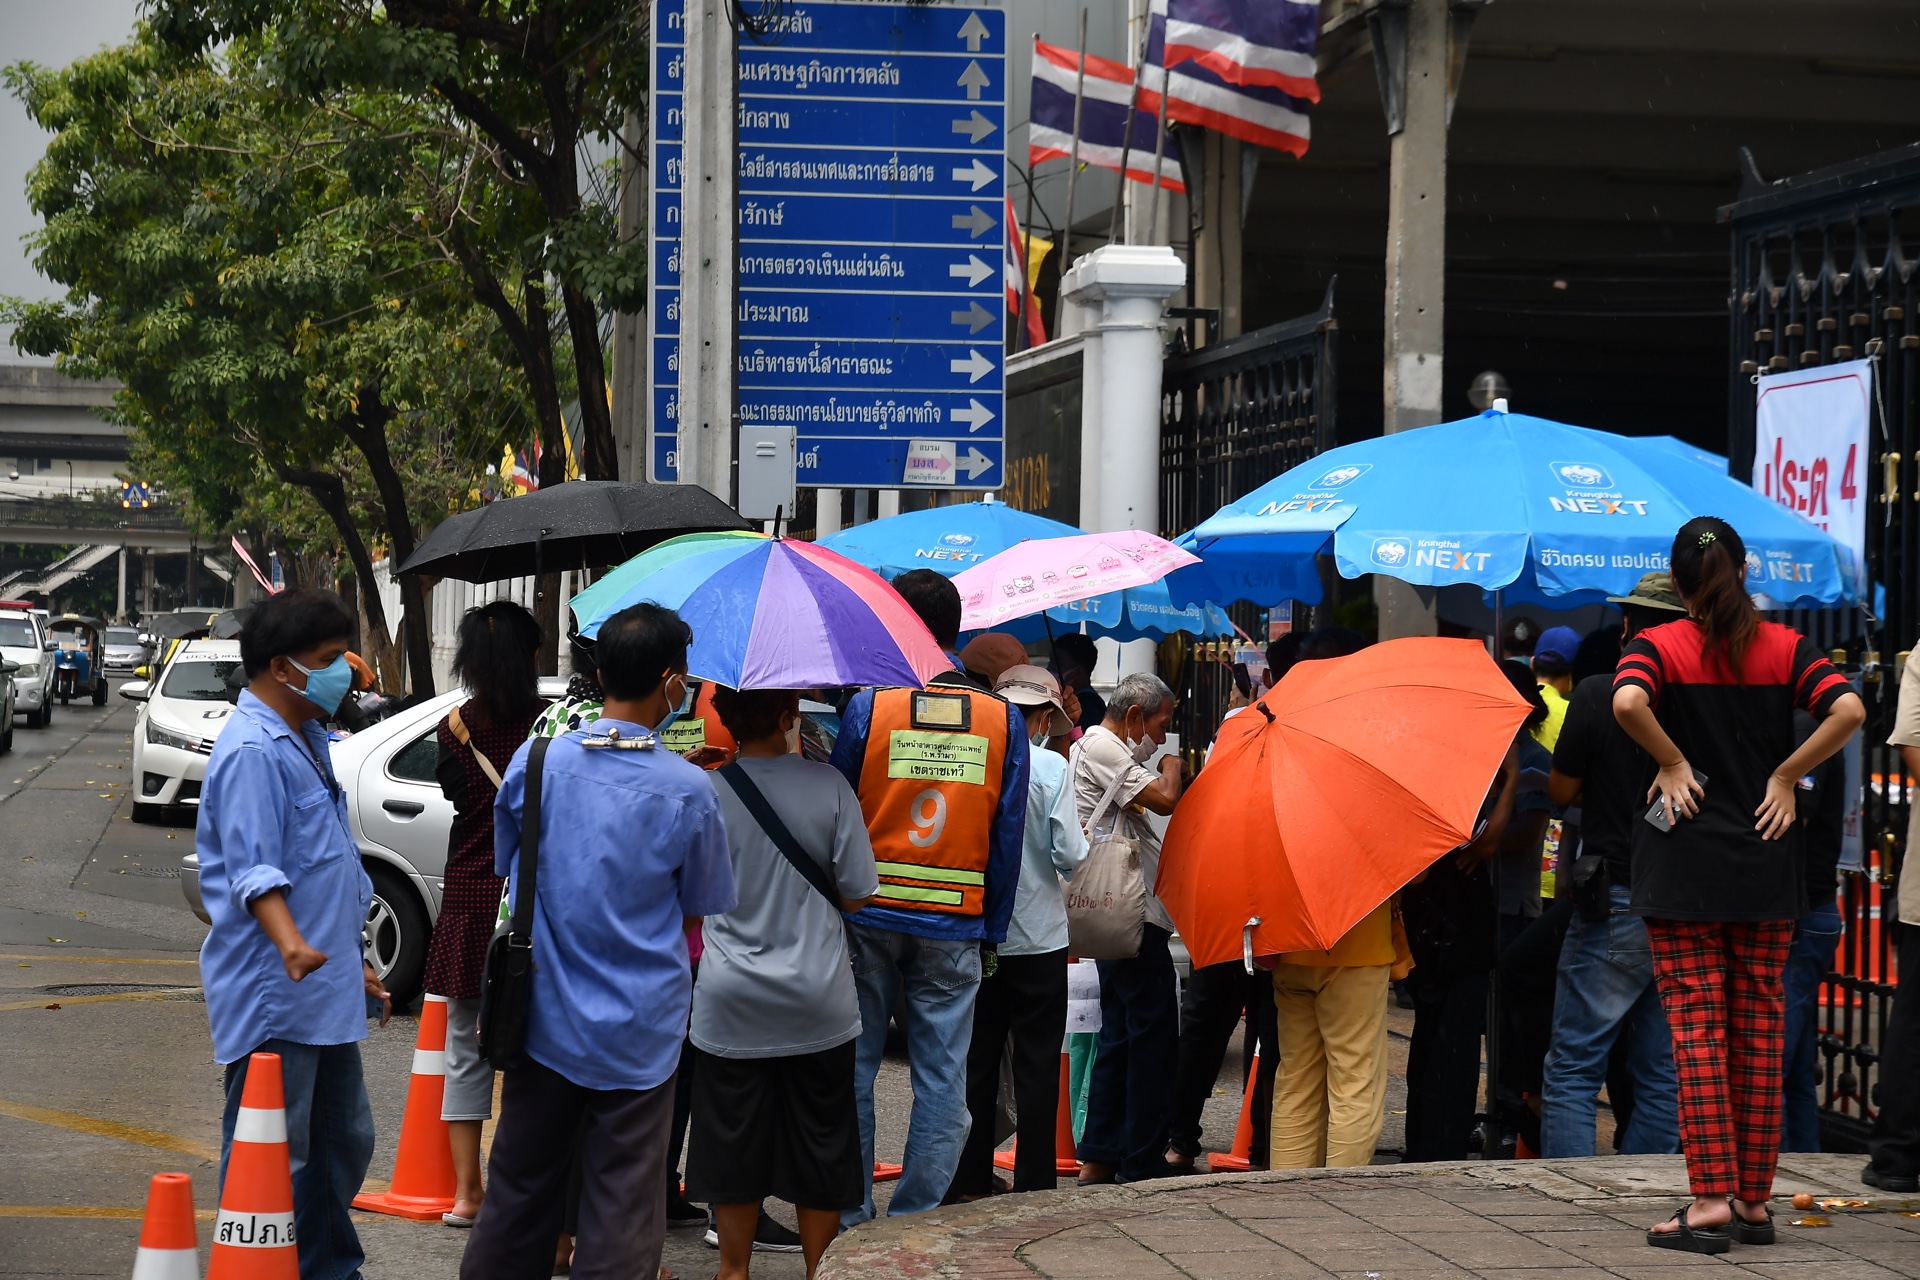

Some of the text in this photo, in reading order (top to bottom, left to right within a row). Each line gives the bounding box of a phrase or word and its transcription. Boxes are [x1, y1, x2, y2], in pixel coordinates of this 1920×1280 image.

[738, 151, 935, 182] โลยีสารสนเทศและการสื่อสาร
[1839, 443, 1857, 513] 4
[1292, 492, 1339, 500] Krungthai
[1564, 490, 1624, 499] Krungthai
[1256, 500, 1344, 516] NEXT
[1548, 496, 1649, 516] NEXT
[1418, 540, 1460, 549] Krungthai
[915, 548, 984, 562] NEXT
[1415, 548, 1492, 571] NEXT
[1541, 548, 1605, 567] ชีวิตครบ
[1767, 561, 1813, 583] NEXT
[1058, 599, 1101, 613] NEXT
[908, 788, 947, 848] 9
